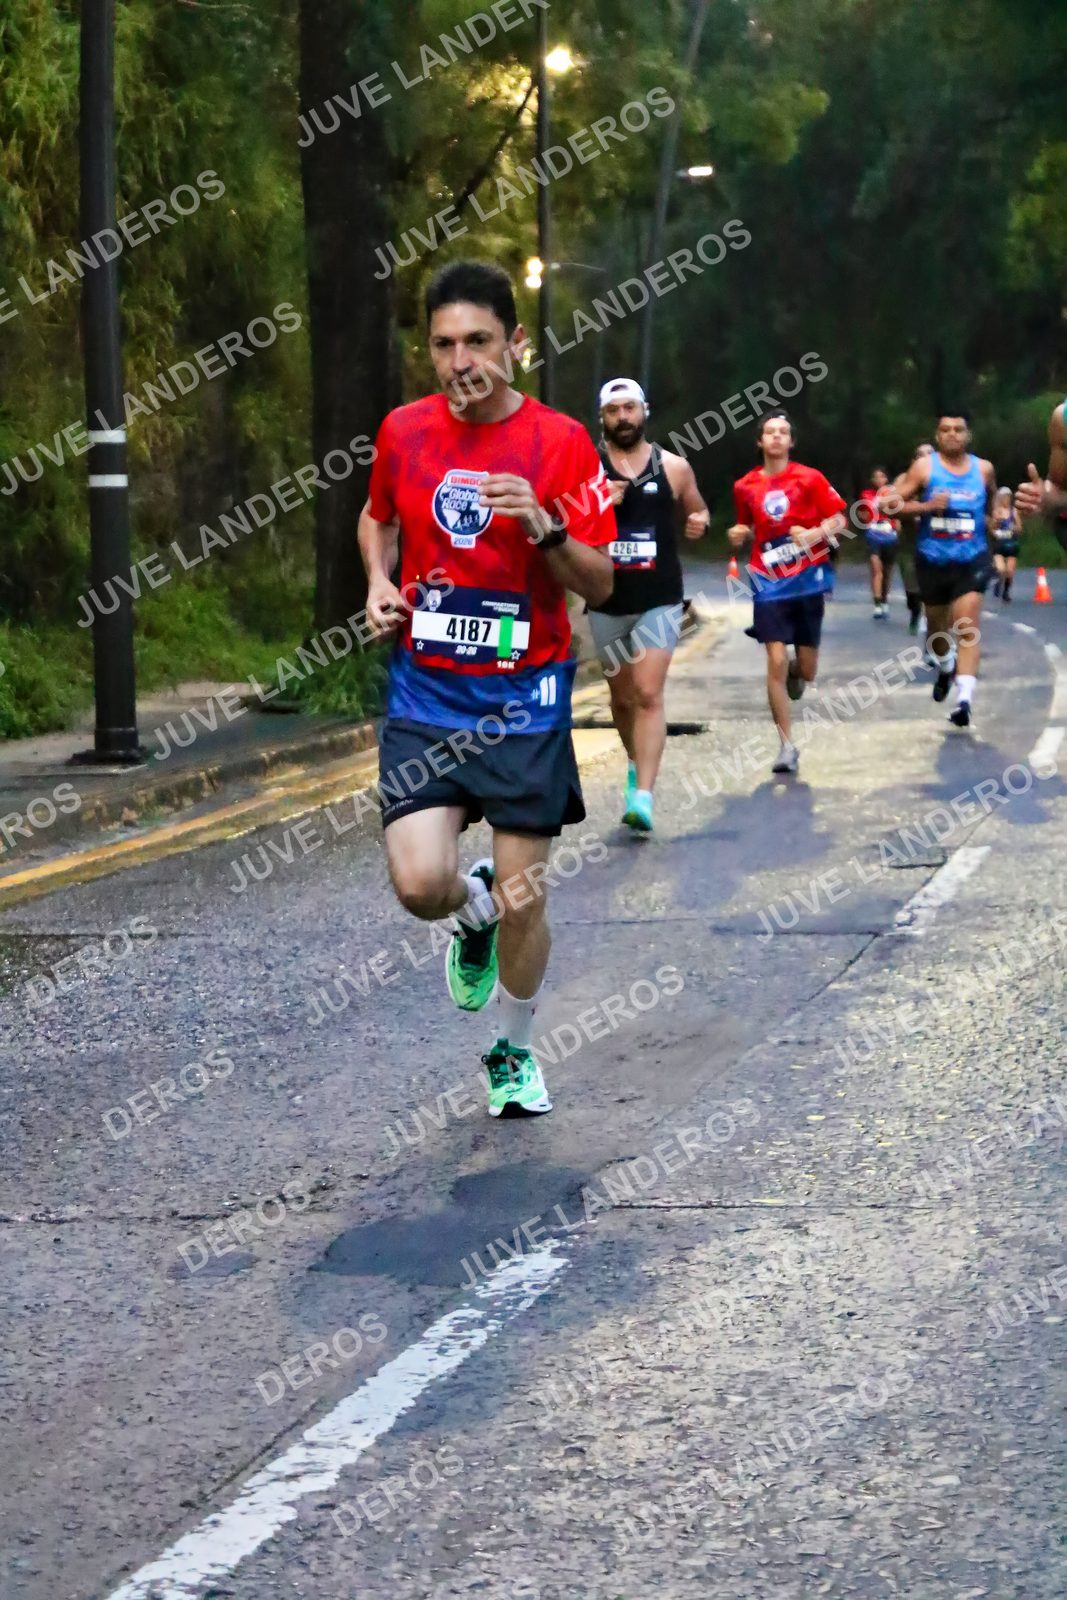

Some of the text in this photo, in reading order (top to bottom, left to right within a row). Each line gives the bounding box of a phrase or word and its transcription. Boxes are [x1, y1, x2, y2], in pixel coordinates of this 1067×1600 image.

[442, 498, 467, 511] Race
[613, 543, 639, 555] 4264
[446, 617, 492, 643] 4187
[496, 660, 515, 670] 10K
